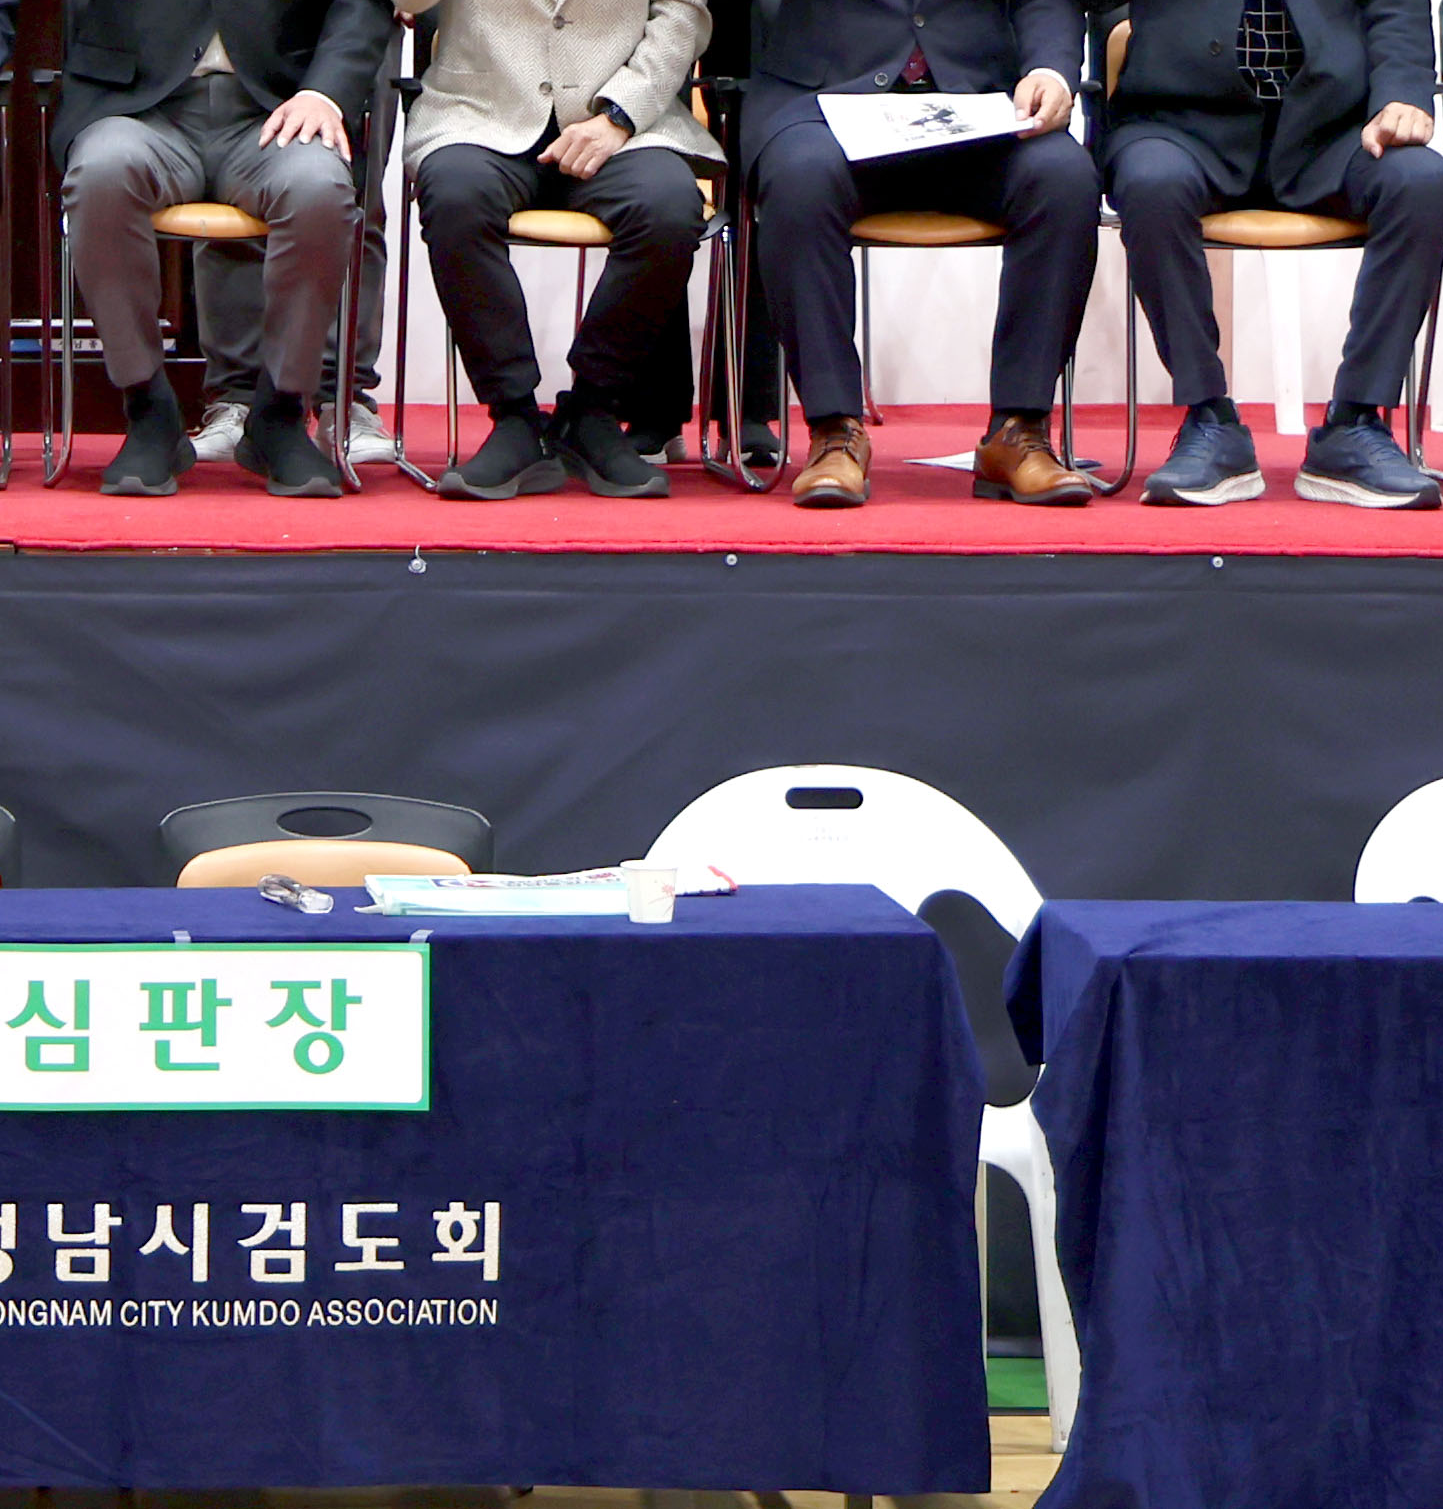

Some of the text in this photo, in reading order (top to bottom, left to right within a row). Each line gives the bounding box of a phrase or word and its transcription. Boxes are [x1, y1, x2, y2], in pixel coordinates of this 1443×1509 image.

[120, 1299, 184, 1327] CITY
[192, 1299, 300, 1327] KUMDO
[307, 1299, 498, 1327] ASSOCIATION
